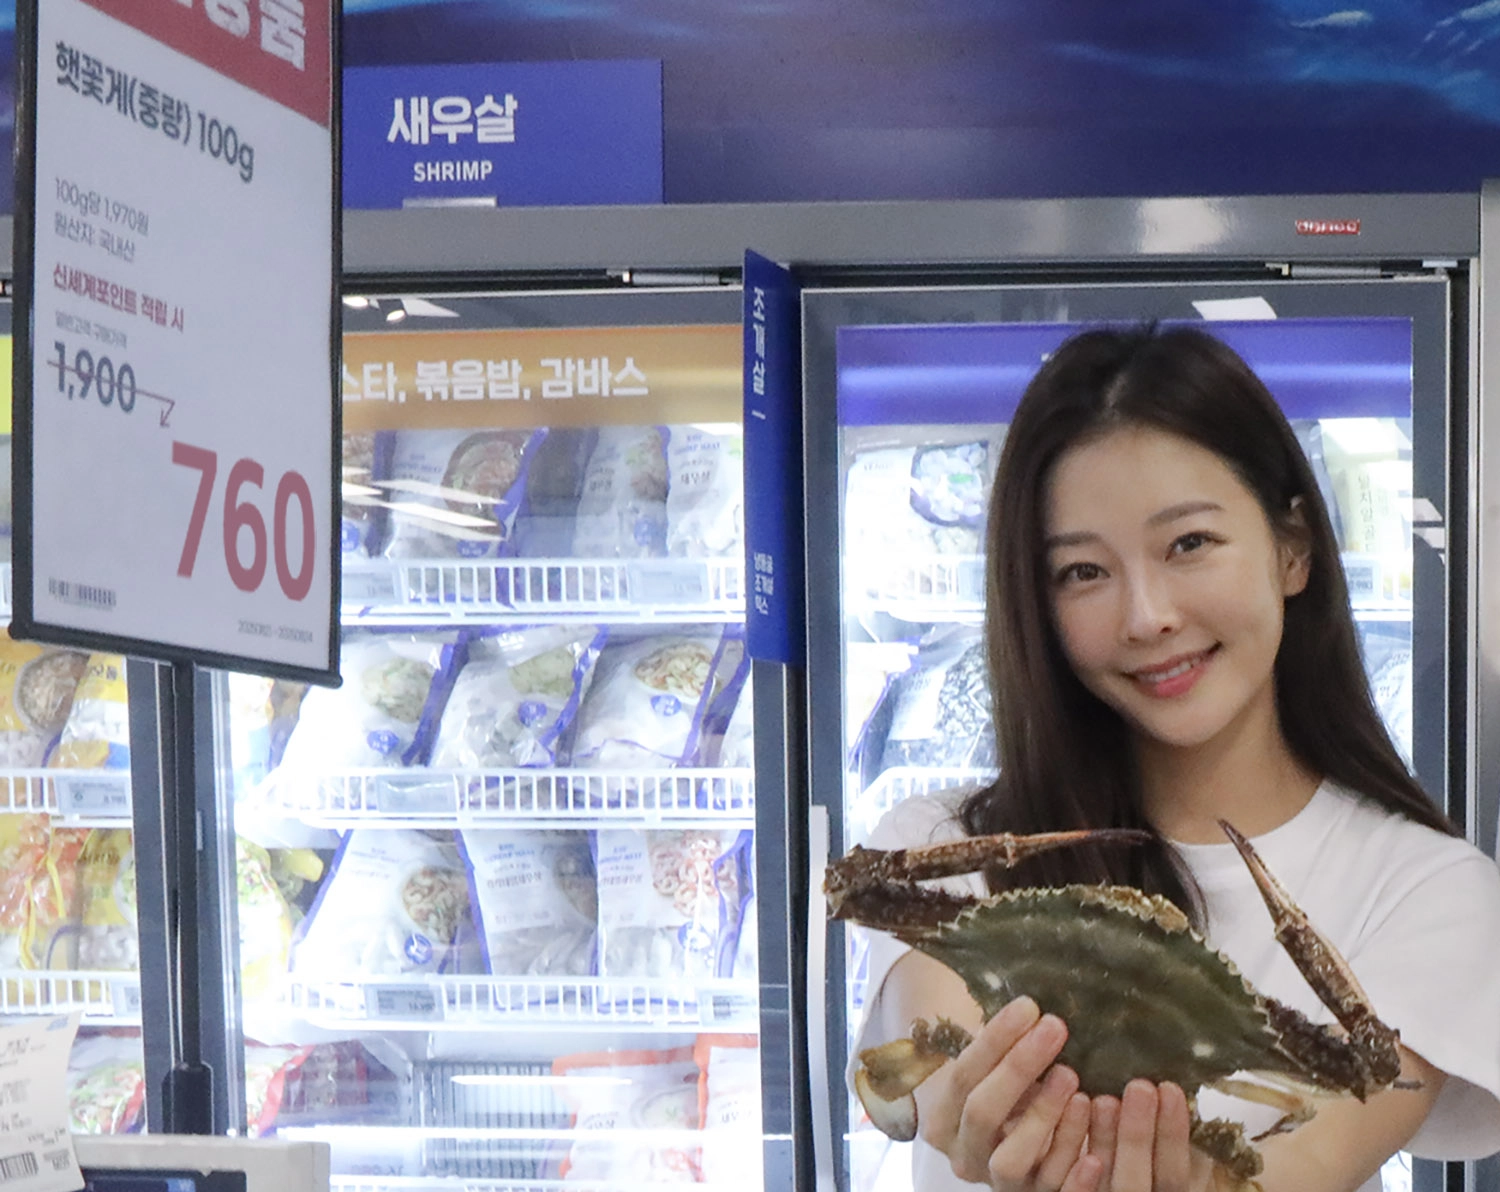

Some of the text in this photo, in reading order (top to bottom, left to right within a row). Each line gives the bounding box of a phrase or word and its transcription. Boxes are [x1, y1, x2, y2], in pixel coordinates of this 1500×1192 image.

[56, 40, 254, 181] 햇꽃게(중량) 100g
[387, 93, 518, 145] 새우살
[413, 160, 493, 182] SHRIMP
[53, 262, 185, 334] 신세계포인트 적립 시
[54, 341, 137, 414] 1,900
[415, 359, 531, 401] 볶음밥,
[541, 356, 649, 398] 감바스
[172, 440, 316, 602] 760
